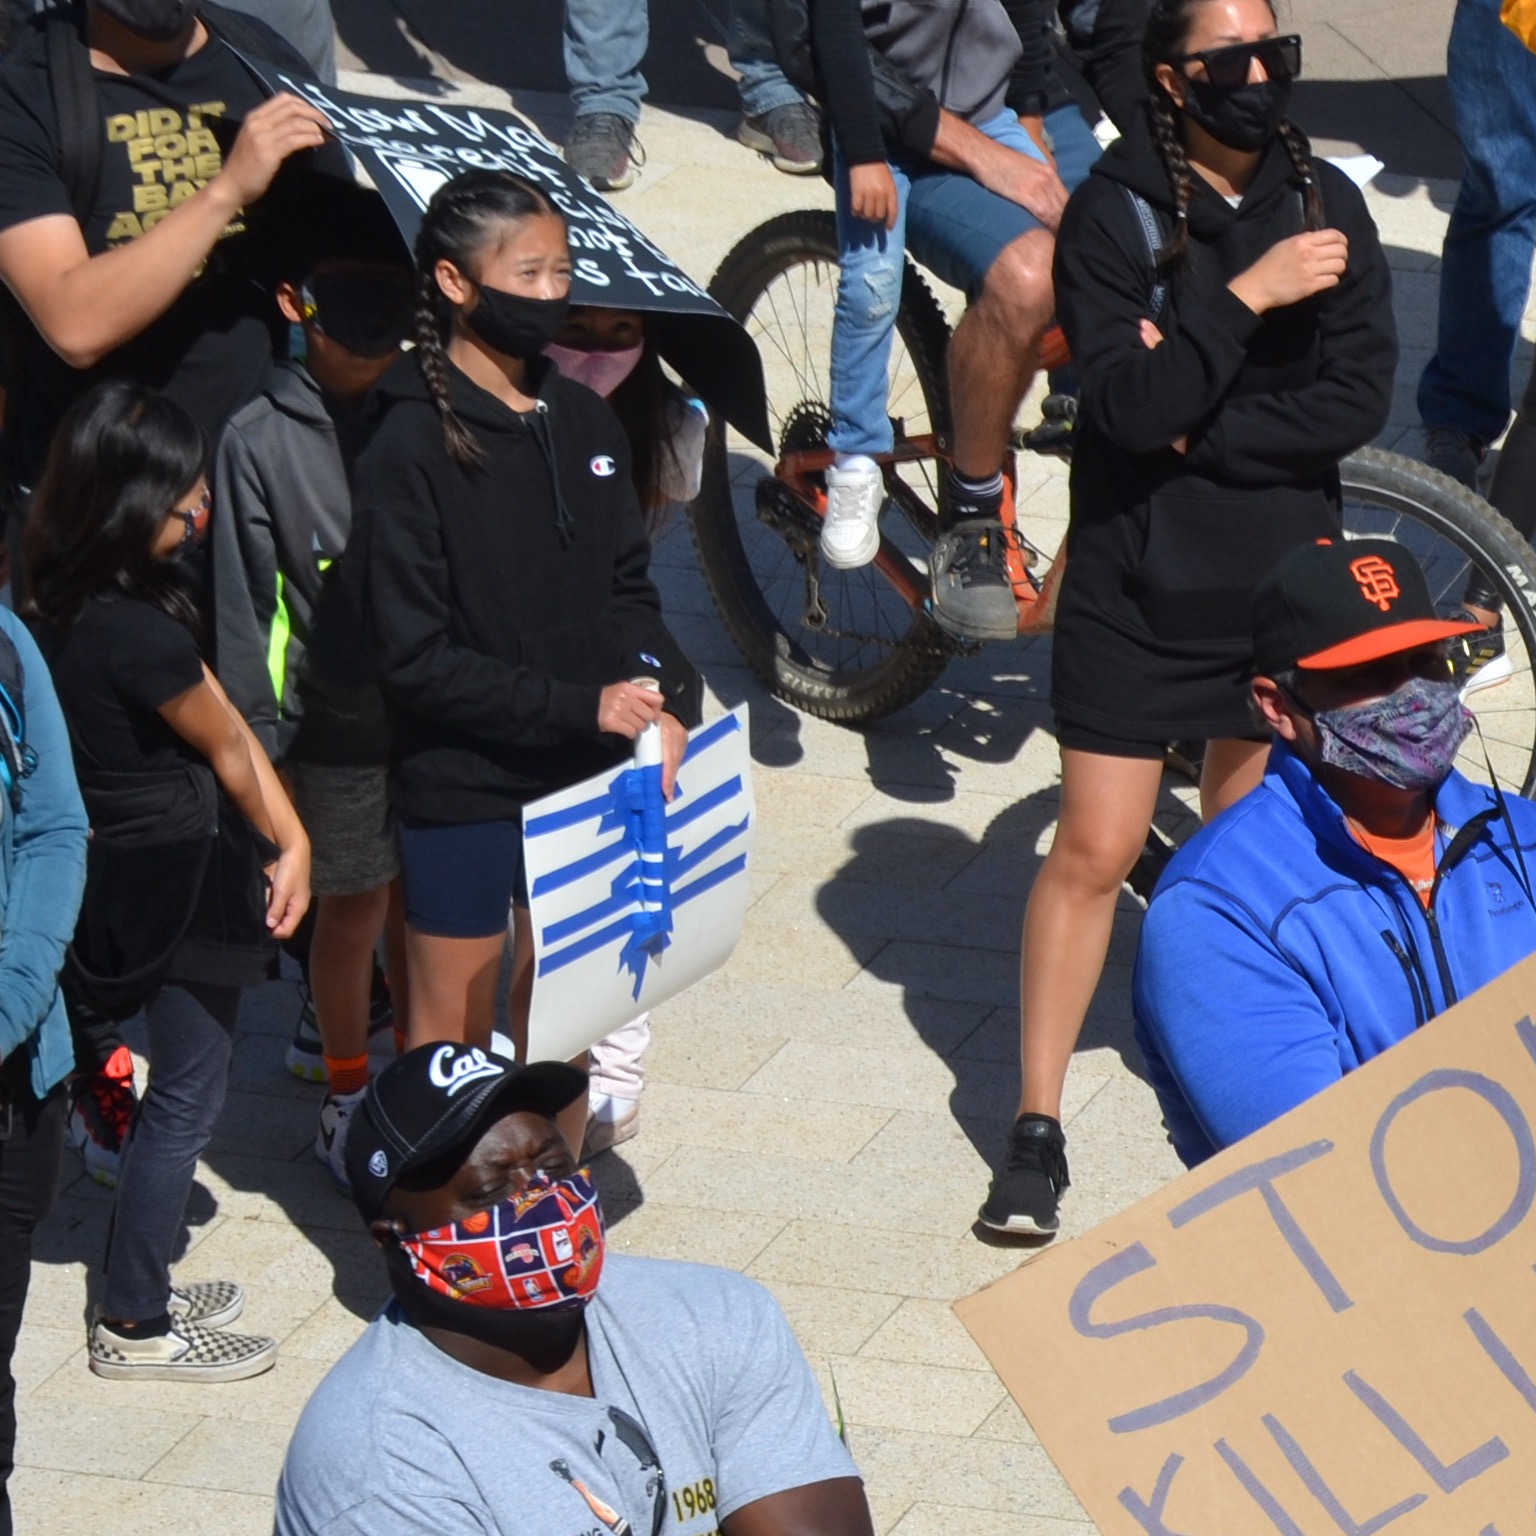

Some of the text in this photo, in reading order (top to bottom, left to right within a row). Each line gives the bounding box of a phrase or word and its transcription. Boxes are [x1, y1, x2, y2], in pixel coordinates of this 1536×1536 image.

[106, 108, 182, 142] DID
[128, 128, 221, 164] FOR
[132, 153, 221, 184] THE
[429, 1045, 504, 1097] Cal
[672, 1478, 717, 1522] 1968
